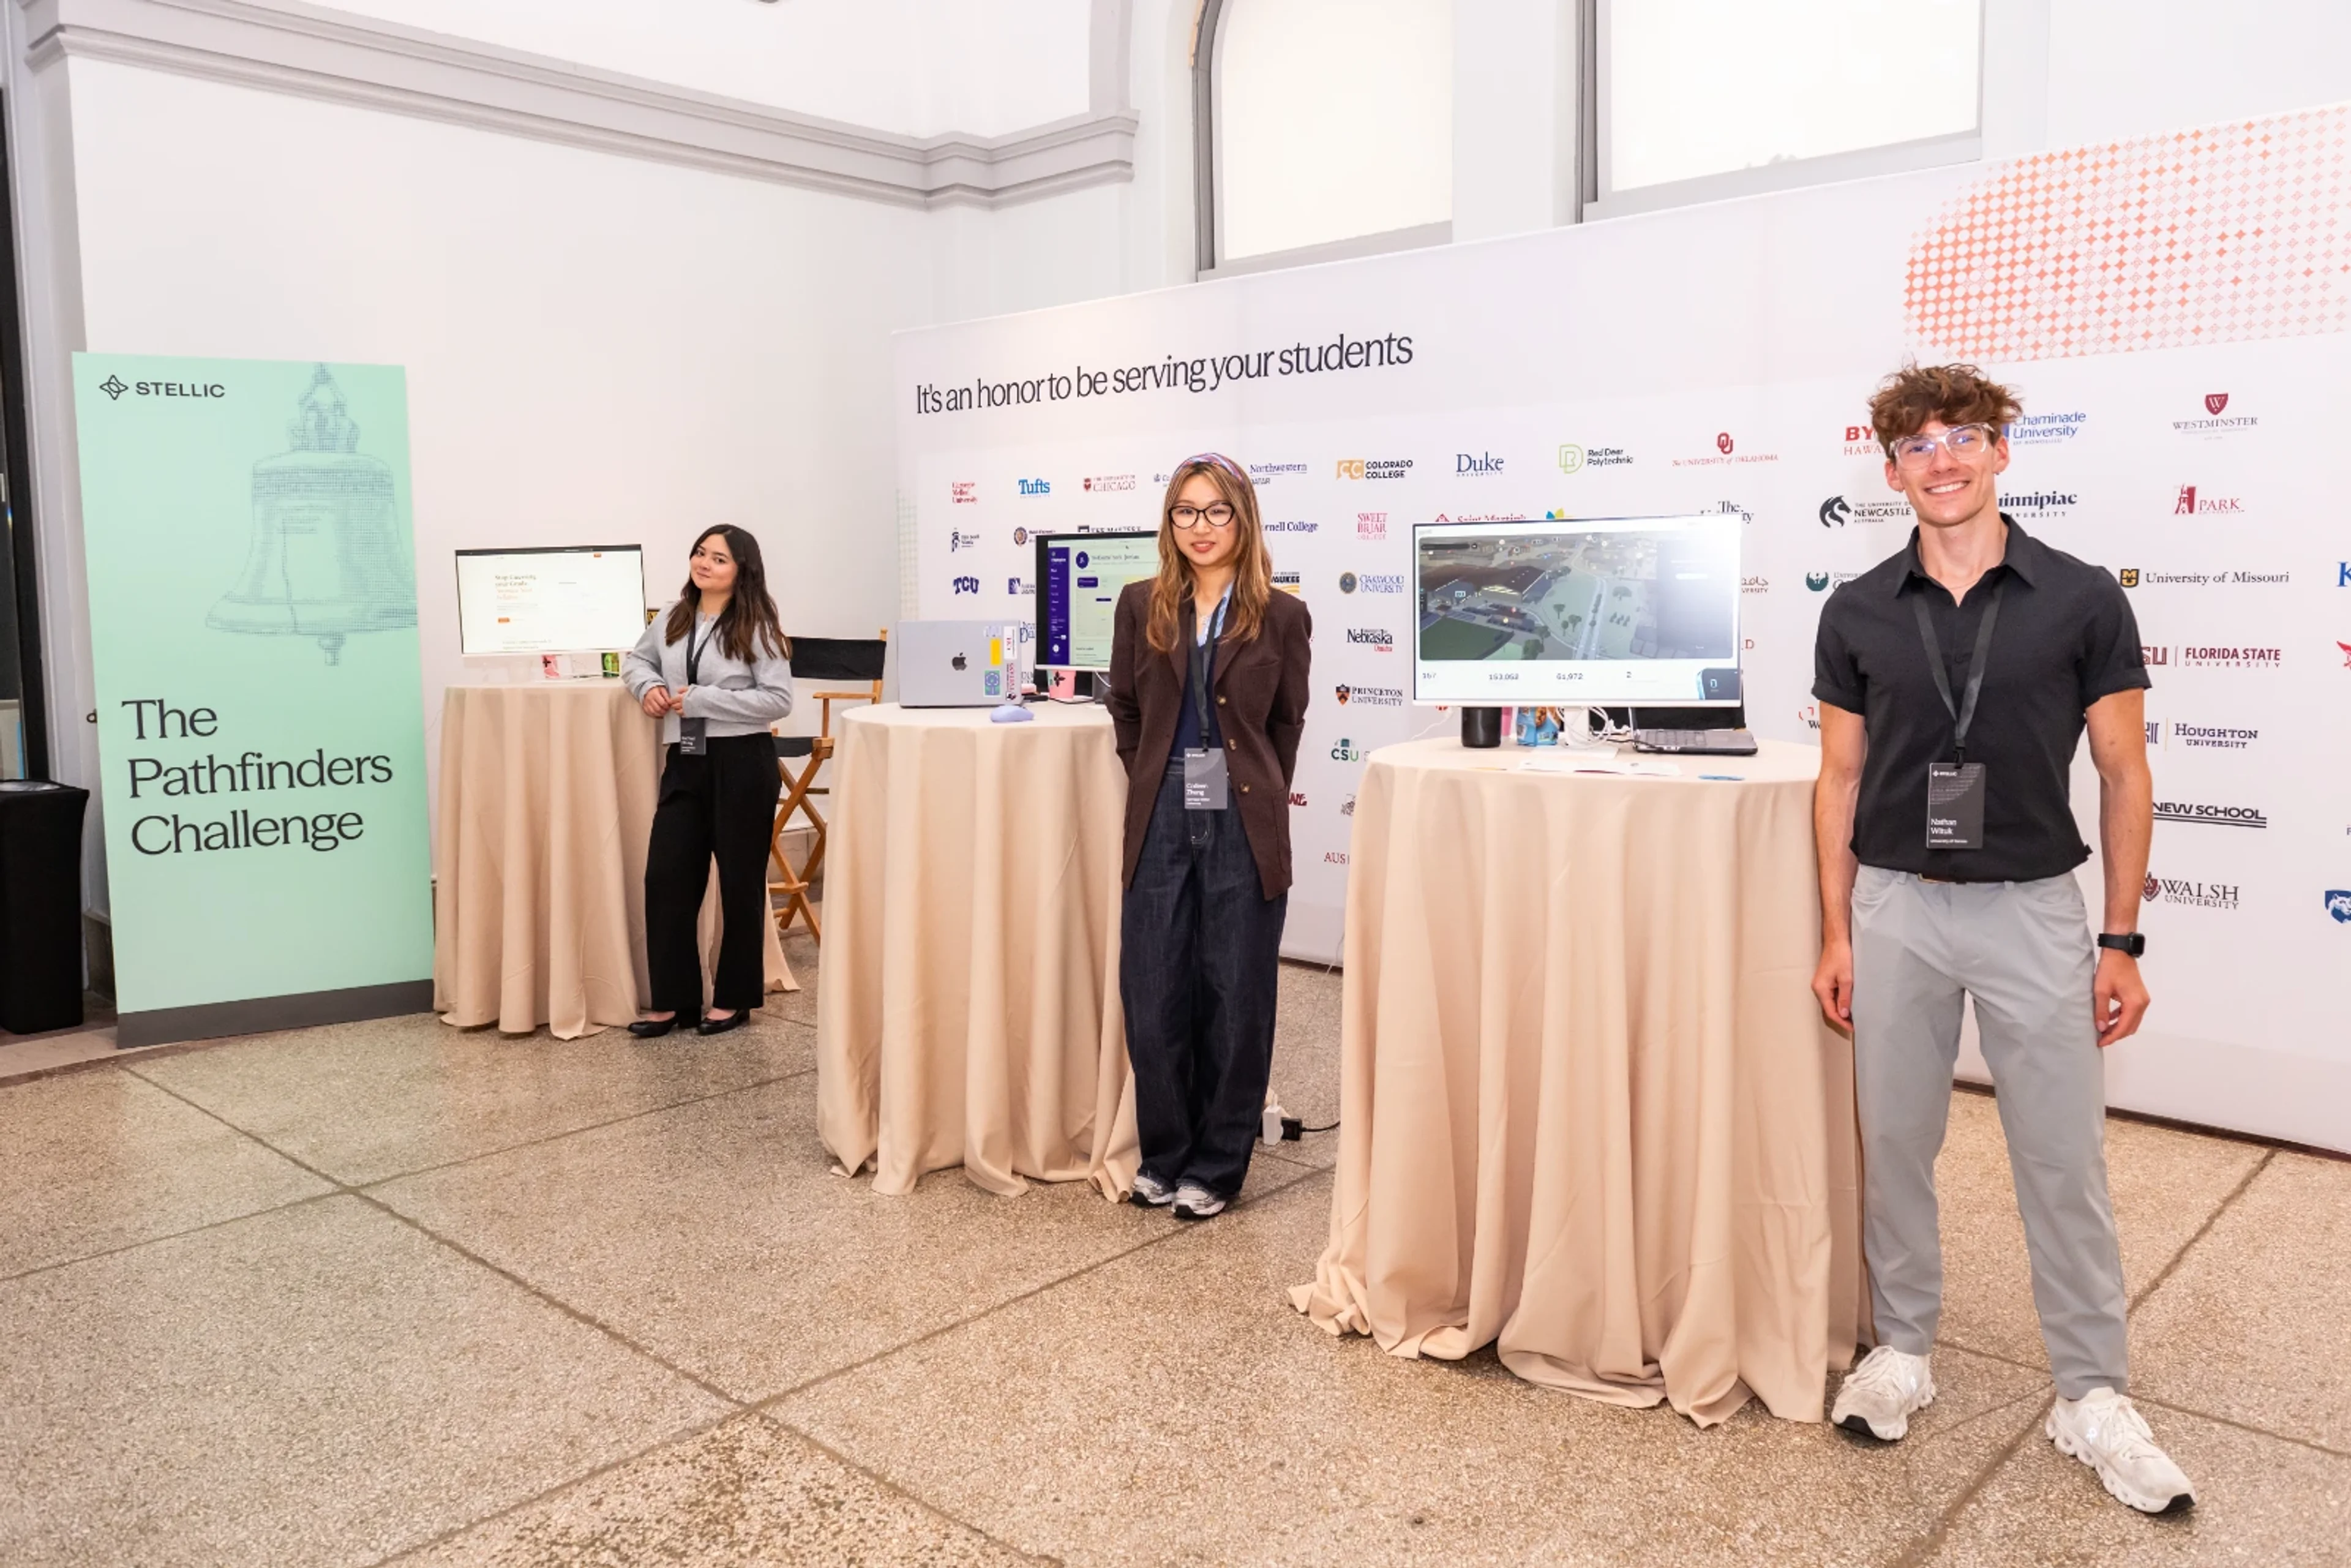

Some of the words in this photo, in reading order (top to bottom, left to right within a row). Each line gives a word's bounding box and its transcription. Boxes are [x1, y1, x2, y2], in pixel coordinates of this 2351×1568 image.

[917, 384, 943, 414] It's
[946, 387, 973, 412] an
[977, 378, 1045, 408] honor
[1048, 373, 1071, 400] to
[1076, 366, 1108, 398] be
[1112, 354, 1206, 393] serving
[1209, 351, 1275, 391] your
[1278, 332, 1414, 376] students
[136, 381, 225, 399] STELLIC
[2172, 417, 2259, 430] WESTMINSTER
[1845, 426, 1875, 441] BY
[2013, 425, 2079, 439] University
[1588, 448, 1603, 457] Red
[1844, 445, 1885, 456] HAWA
[1250, 463, 1308, 474] Northwestern
[1365, 460, 1413, 470] COLORADO
[1456, 451, 1504, 473] Duke
[1587, 456, 1633, 467] Polytechnic
[1365, 470, 1406, 479] COLLEGE
[1018, 478, 1051, 495] Tufts
[1093, 481, 1136, 492] CHICAGO
[1998, 490, 2077, 510] innipiac
[2199, 498, 2241, 511] PARK
[1357, 512, 1388, 523] SWEET
[1854, 507, 1911, 517] NEWCASTLE
[1264, 522, 1285, 531] rnell
[1287, 521, 1319, 533] College
[1357, 522, 1387, 535] BRIAR
[1359, 575, 1404, 585] OAKWOOD
[2145, 572, 2210, 585] University
[2213, 571, 2229, 583] of
[2232, 571, 2290, 583] Missouri
[953, 576, 980, 595] TCU
[1360, 584, 1404, 593] UNIVERSITY
[1347, 628, 1393, 644] Nebraska
[2142, 647, 2168, 666] SU
[2185, 647, 2239, 659] FLORIDA
[2242, 648, 2281, 661] STATE
[1352, 686, 1403, 697] PRINCETON
[1352, 696, 1403, 707] UNIVERSITY
[121, 698, 218, 740] The
[2175, 723, 2259, 740] HOUGHTON
[2186, 738, 2248, 749] UNIVERSITY
[1331, 748, 1359, 762] CSU
[127, 748, 393, 798] Pathfinders
[2153, 802, 2194, 815] NEW
[2195, 805, 2267, 821] SCHOOL
[131, 809, 364, 855] Challenge
[2161, 879, 2240, 901] WALSH
[2164, 894, 2240, 910] UNIVERSITY
